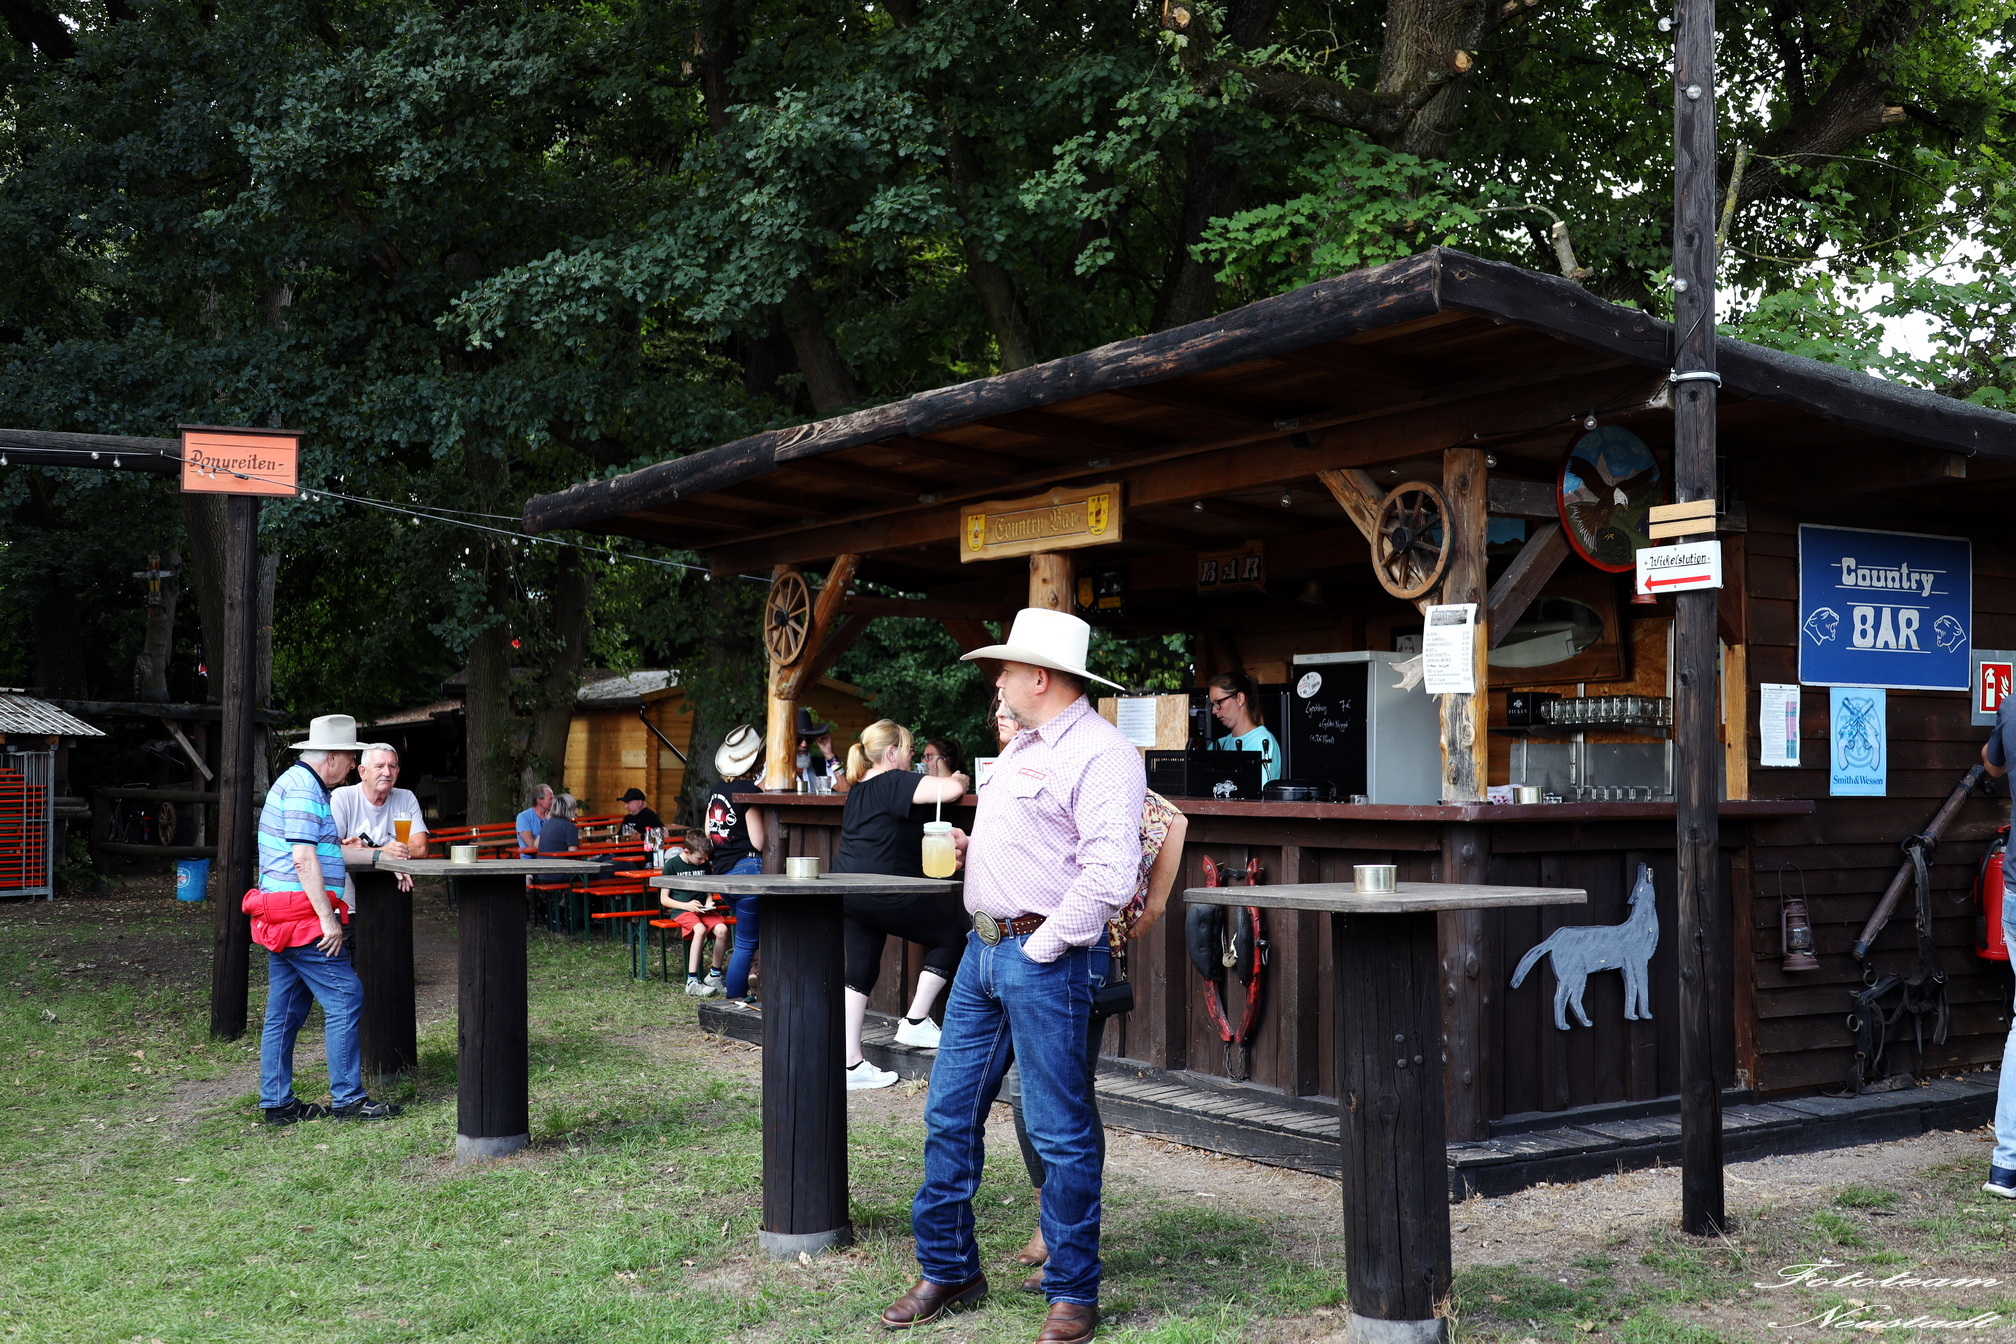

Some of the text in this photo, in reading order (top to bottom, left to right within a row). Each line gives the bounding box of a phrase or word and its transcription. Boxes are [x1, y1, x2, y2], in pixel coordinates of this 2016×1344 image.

[994, 507, 1076, 541] Country Bar
[1199, 556, 1260, 583] BAR
[1649, 552, 1707, 567] Wickelstation
[1841, 557, 1935, 597] Country
[1852, 606, 1921, 650] BAR
